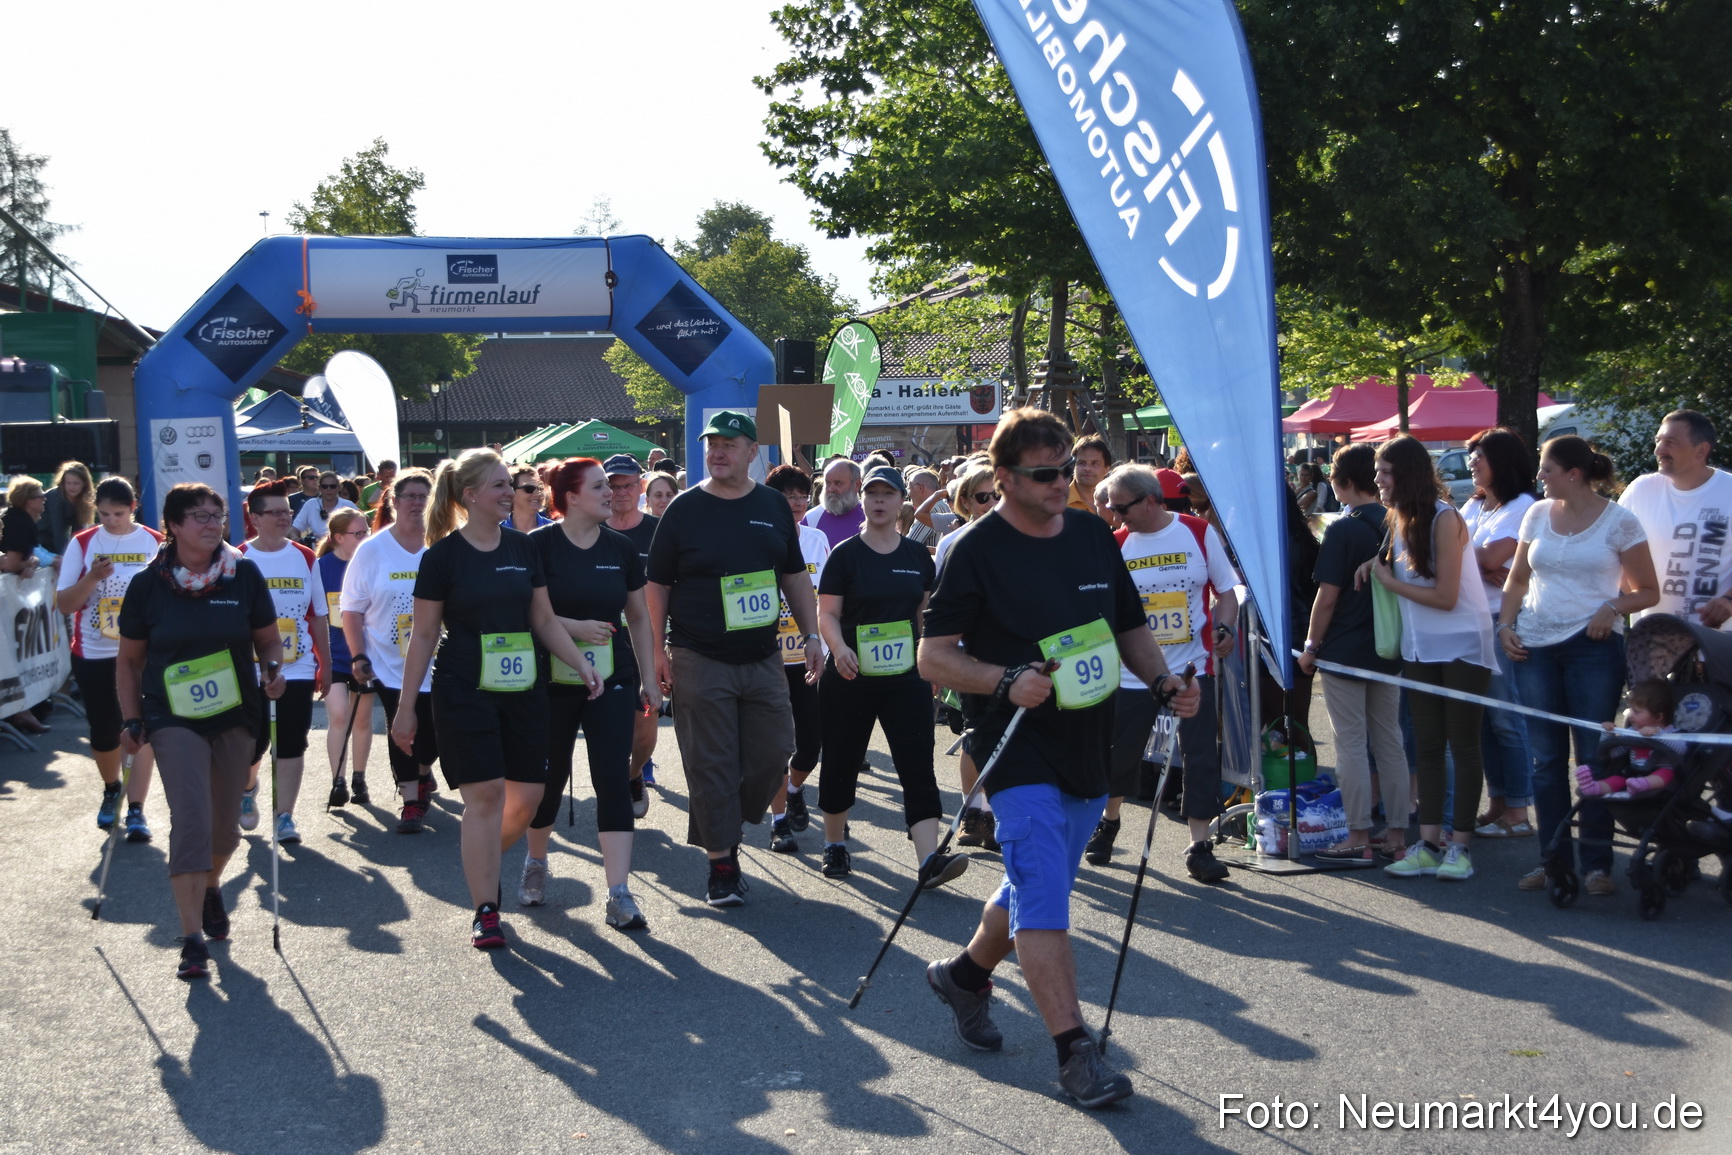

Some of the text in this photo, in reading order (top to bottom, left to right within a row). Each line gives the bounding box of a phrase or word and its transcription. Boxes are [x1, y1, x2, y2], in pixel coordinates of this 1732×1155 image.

[430, 284, 541, 304] firmenlauf
[212, 327, 274, 339] Fischer
[656, 322, 672, 331] und
[674, 320, 689, 328] das
[1128, 554, 1181, 570] ONLINE
[1662, 522, 1698, 597] BFLD
[737, 593, 770, 613] 108
[871, 643, 904, 662] 107
[501, 656, 523, 675] 96
[1075, 655, 1103, 684] 99
[190, 679, 218, 703] 90
